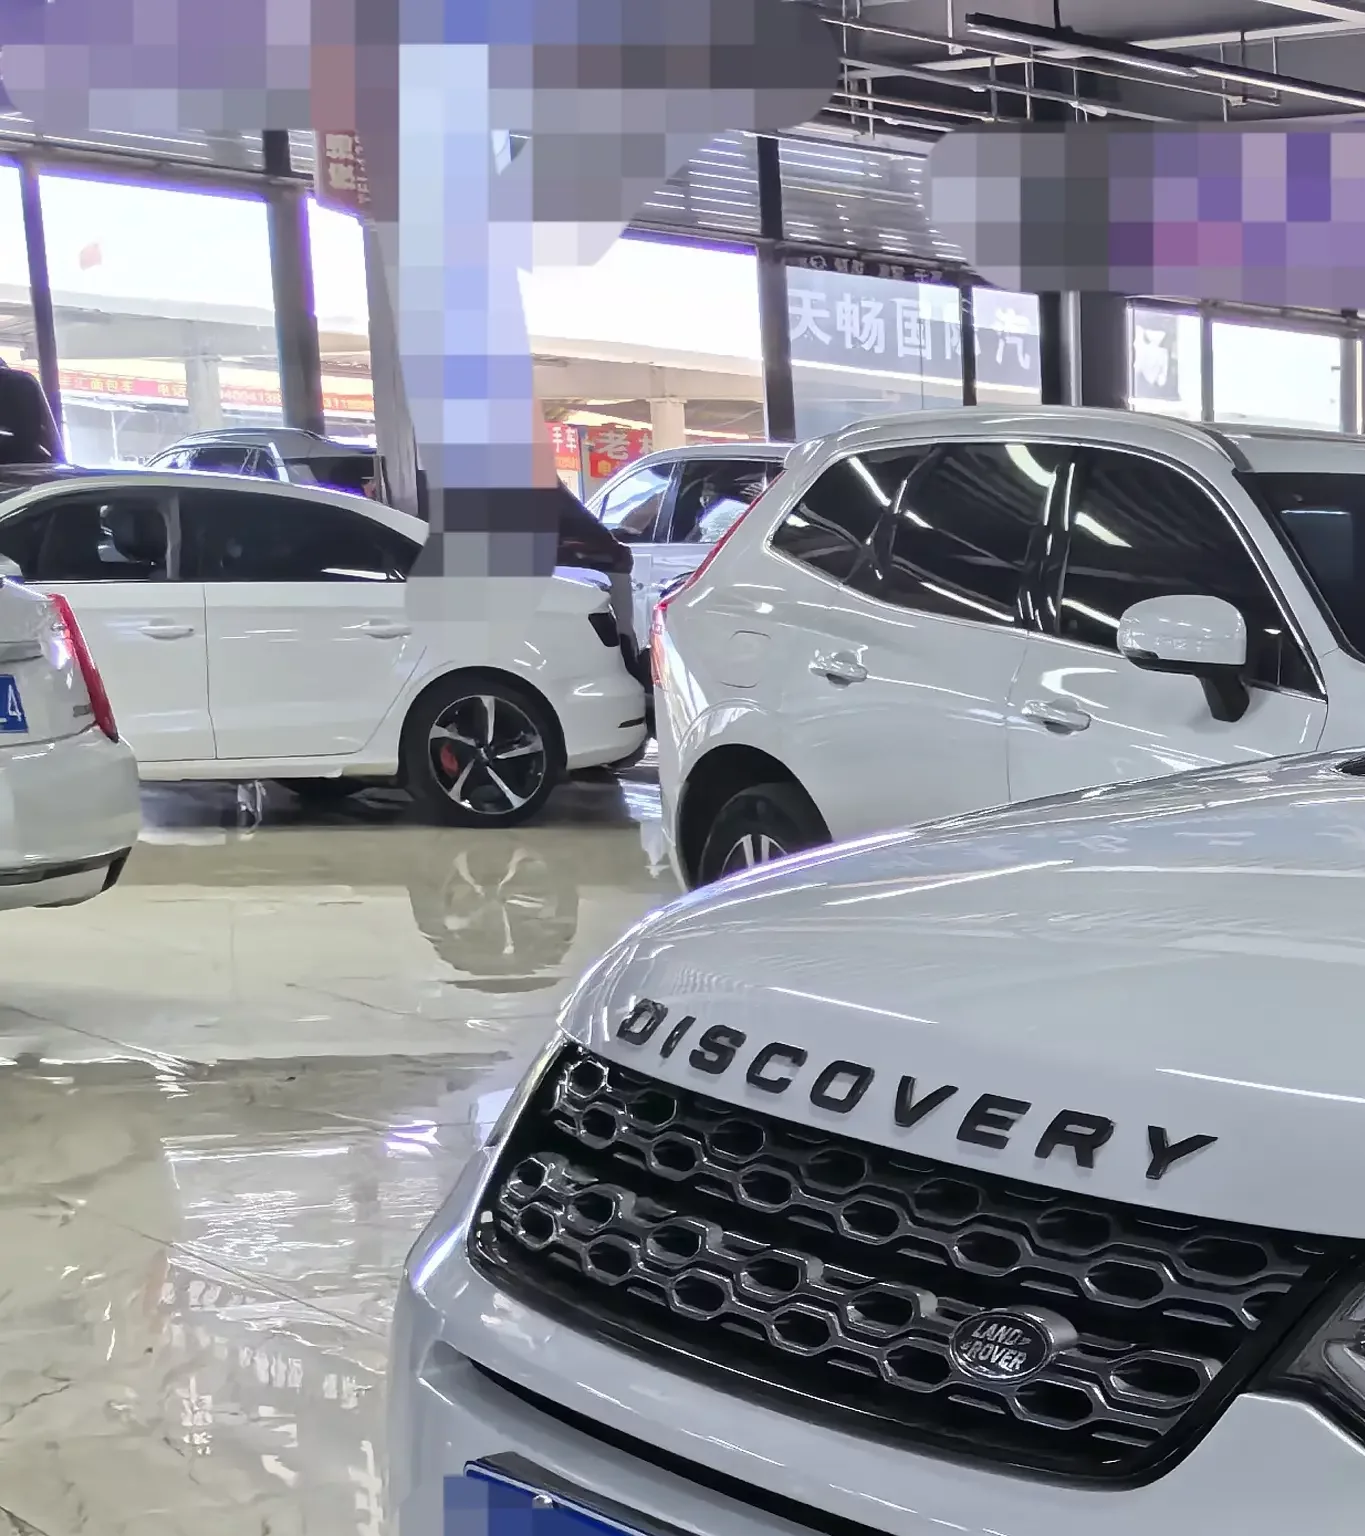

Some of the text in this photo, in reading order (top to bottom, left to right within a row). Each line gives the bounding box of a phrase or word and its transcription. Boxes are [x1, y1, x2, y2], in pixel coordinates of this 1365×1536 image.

[616, 998, 1219, 1180] DISCOVERY
[971, 1320, 1024, 1346] LAND
[966, 1340, 1028, 1373] ROVER
